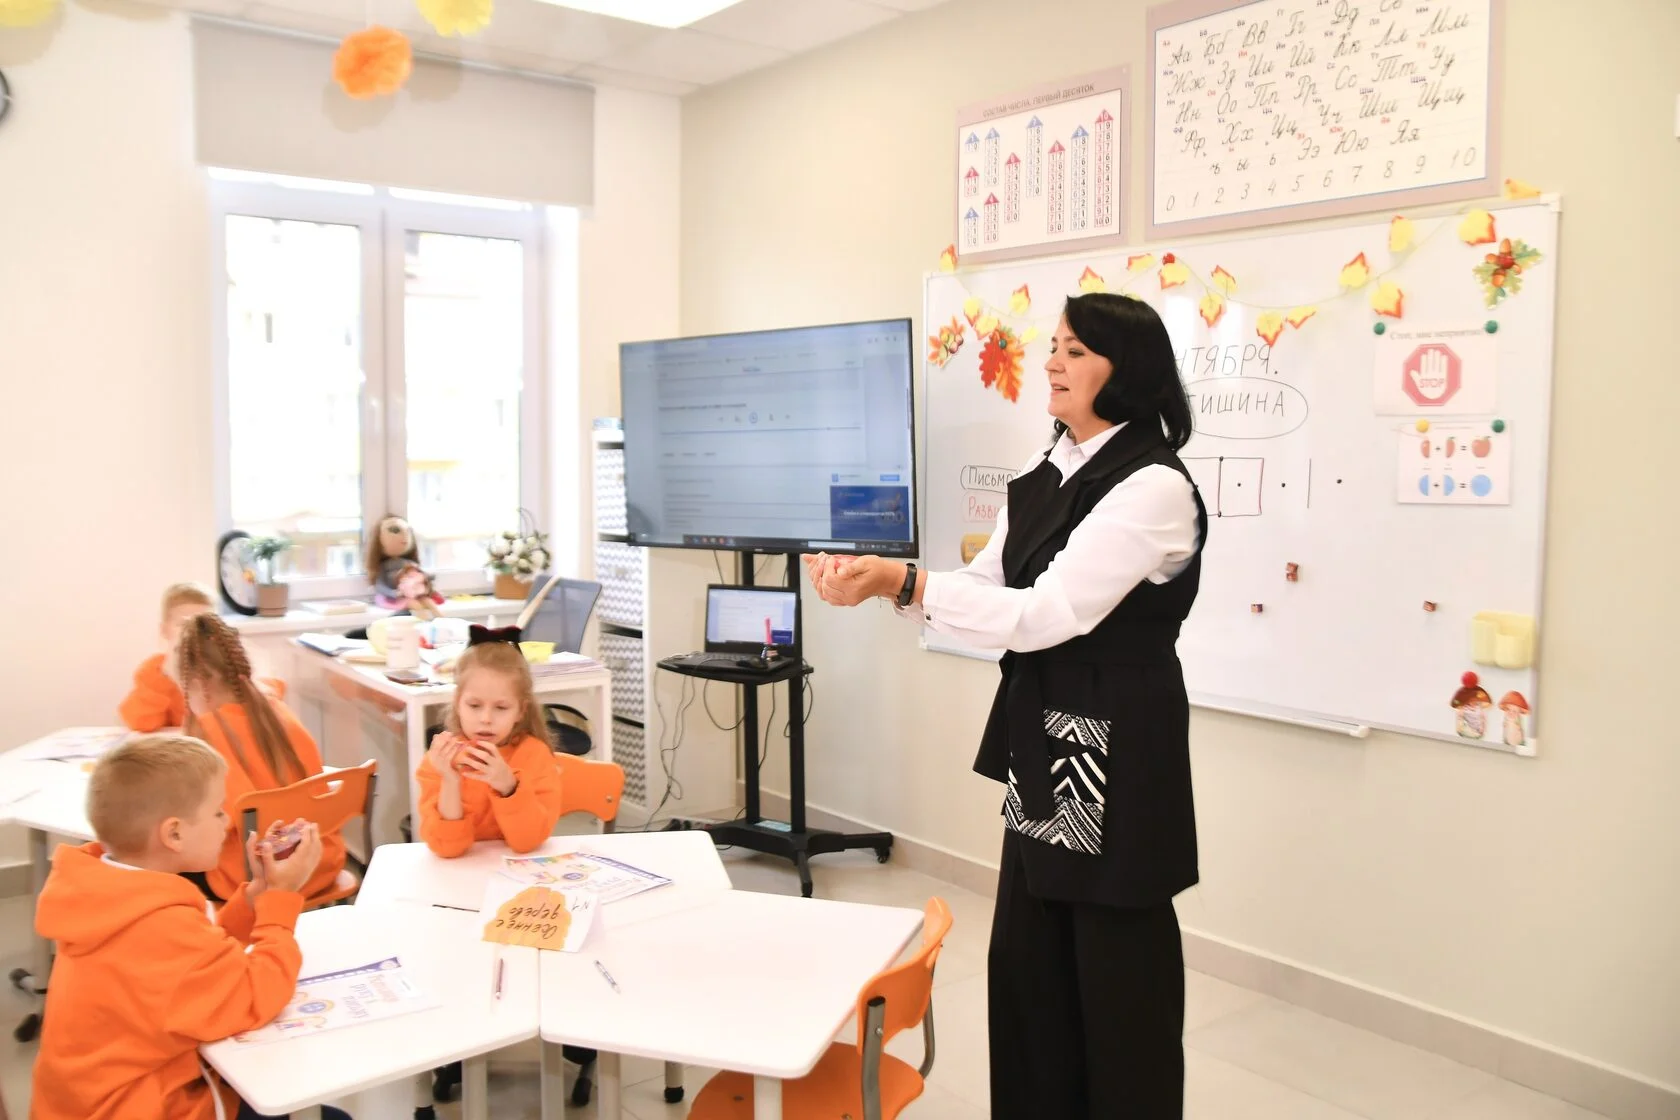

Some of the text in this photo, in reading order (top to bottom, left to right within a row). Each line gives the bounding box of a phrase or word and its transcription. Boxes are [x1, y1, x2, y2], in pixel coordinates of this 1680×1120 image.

[1062, 83, 1096, 100] ДЕСЯТОК
[1165, 195, 1176, 212] 0
[1192, 192, 1200, 208] 1
[1214, 186, 1225, 204] 2
[1240, 182, 1251, 200] 3
[1266, 178, 1278, 197] 4
[1290, 174, 1306, 192] 5
[1322, 169, 1334, 188] 6
[1352, 164, 1364, 184] 7
[1383, 160, 1395, 179] 8
[1413, 154, 1427, 174] 9
[1174, 343, 1279, 376] НТЯБРЯ.
[1418, 377, 1446, 389] STOP
[508, 903, 561, 921] дерево
[495, 919, 558, 940] Осеннее
